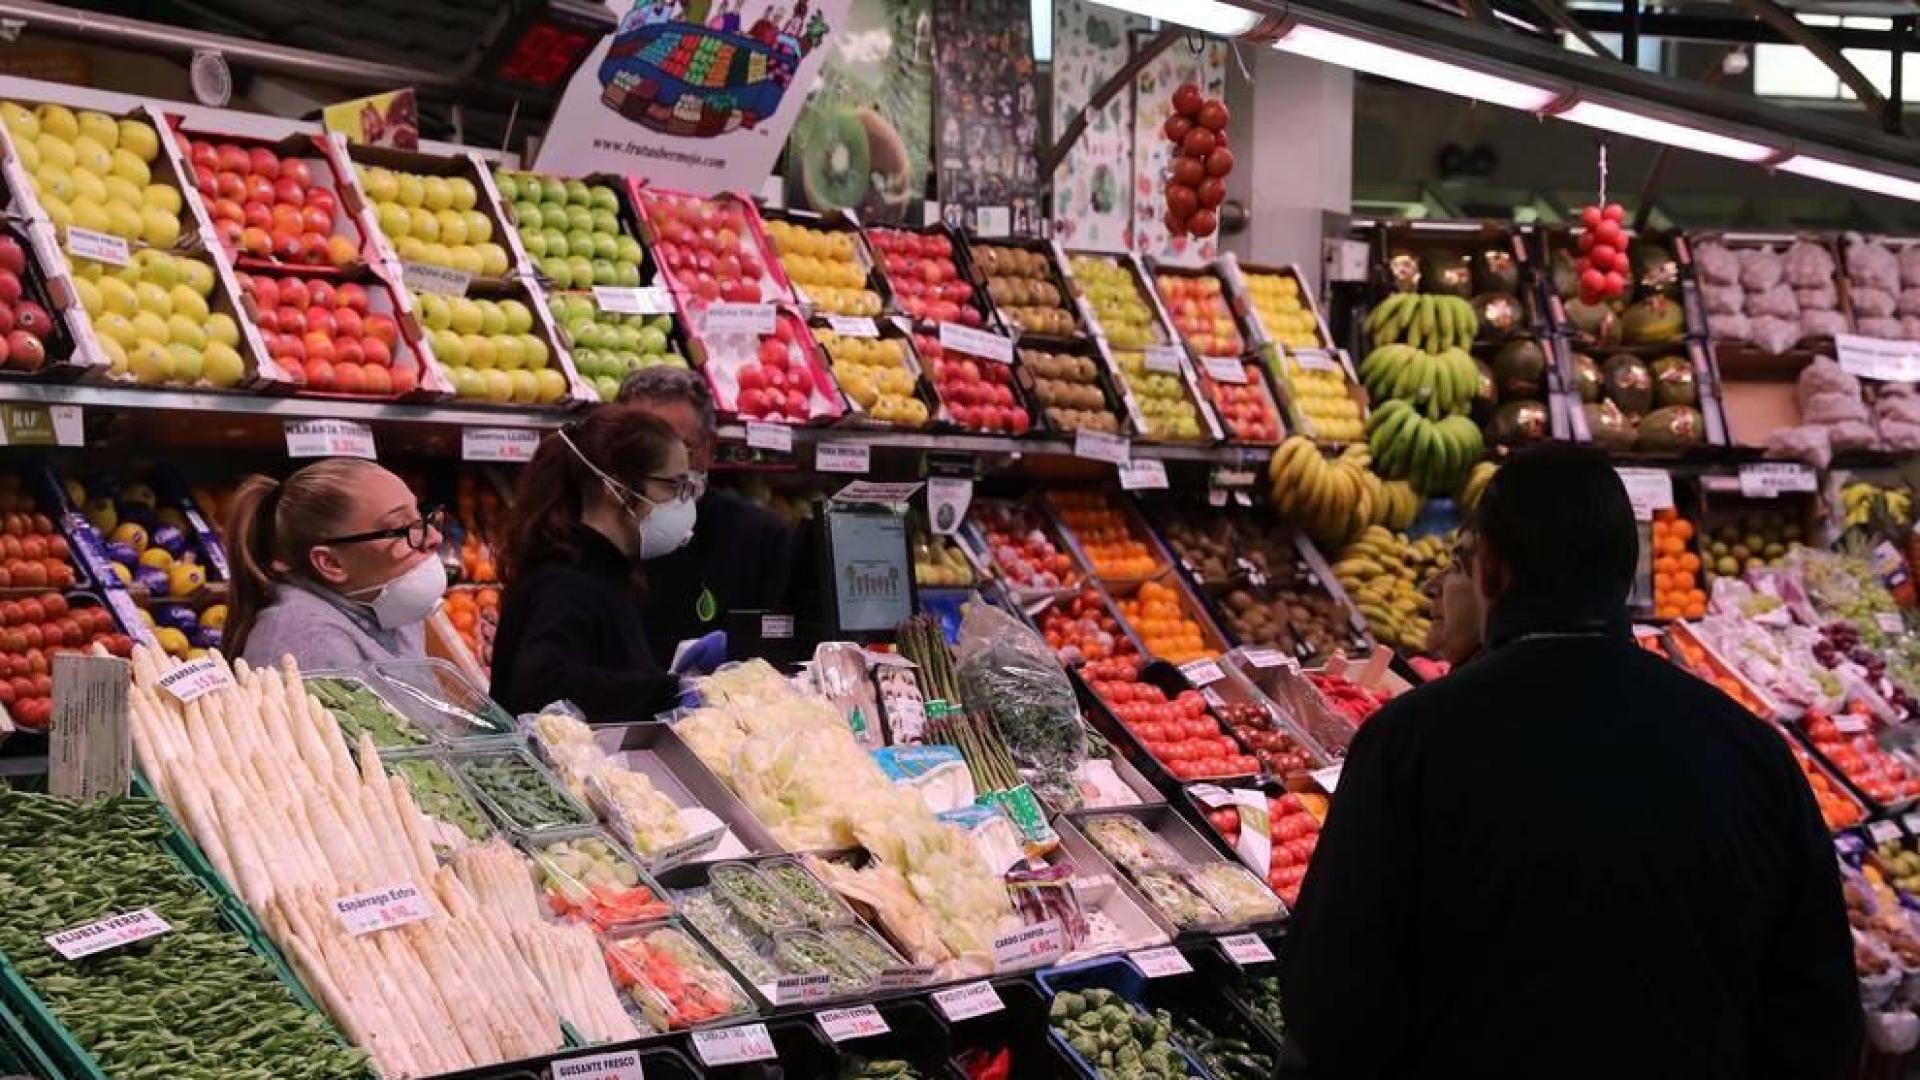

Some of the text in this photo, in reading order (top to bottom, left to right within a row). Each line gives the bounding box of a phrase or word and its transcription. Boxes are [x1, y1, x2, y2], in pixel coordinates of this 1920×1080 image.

[388, 888, 416, 900] Extra
[56, 912, 149, 944] ALUBIA VERDE
[995, 935, 1019, 949] CARDO
[603, 1056, 635, 1070] FRESCO
